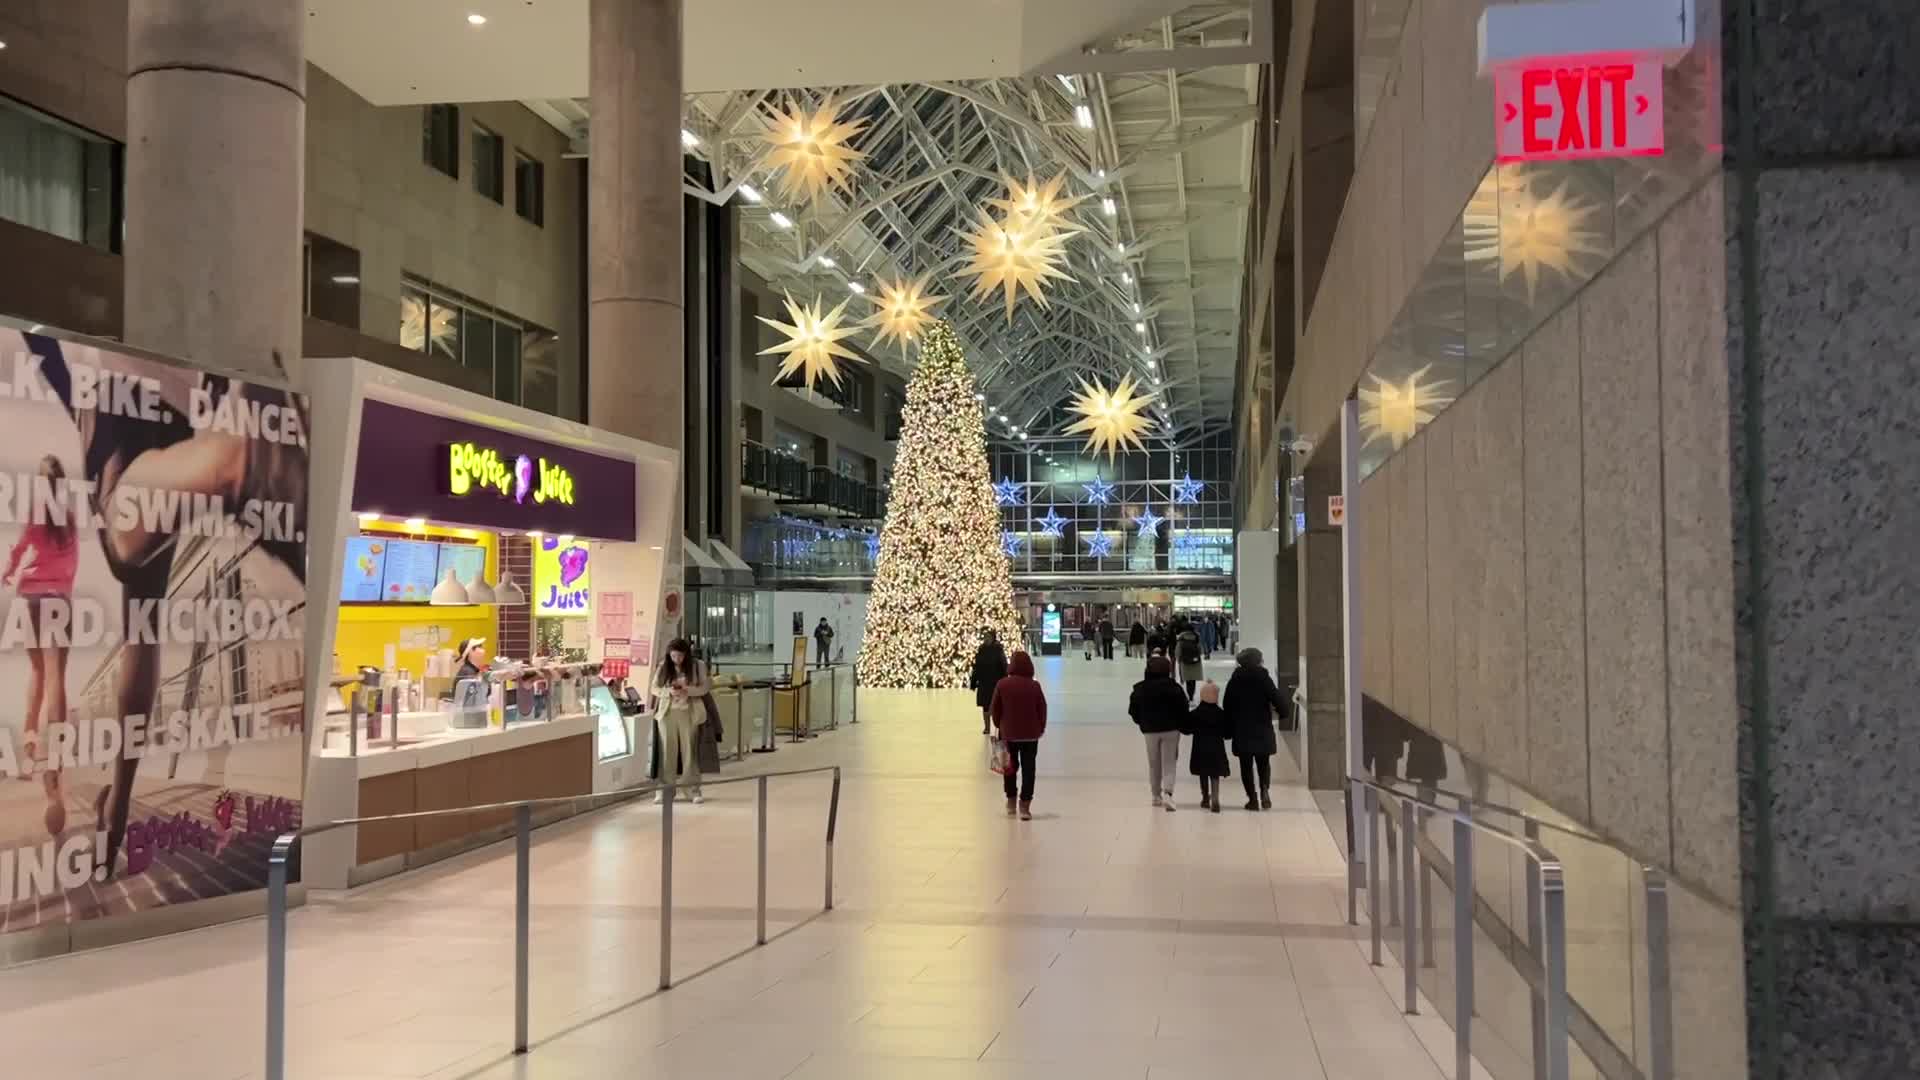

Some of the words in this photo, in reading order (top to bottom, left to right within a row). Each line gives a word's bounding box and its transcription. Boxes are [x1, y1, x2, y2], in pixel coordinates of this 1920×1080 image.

[1521, 63, 1635, 153] EXIT
[71, 364, 174, 425] BIKE.
[189, 386, 307, 448] DANCE.
[450, 442, 512, 496] Booster
[533, 457, 574, 505] Juice
[115, 484, 236, 538] SWIM.
[243, 498, 305, 544] SKI.
[0, 830, 109, 905] ING!
